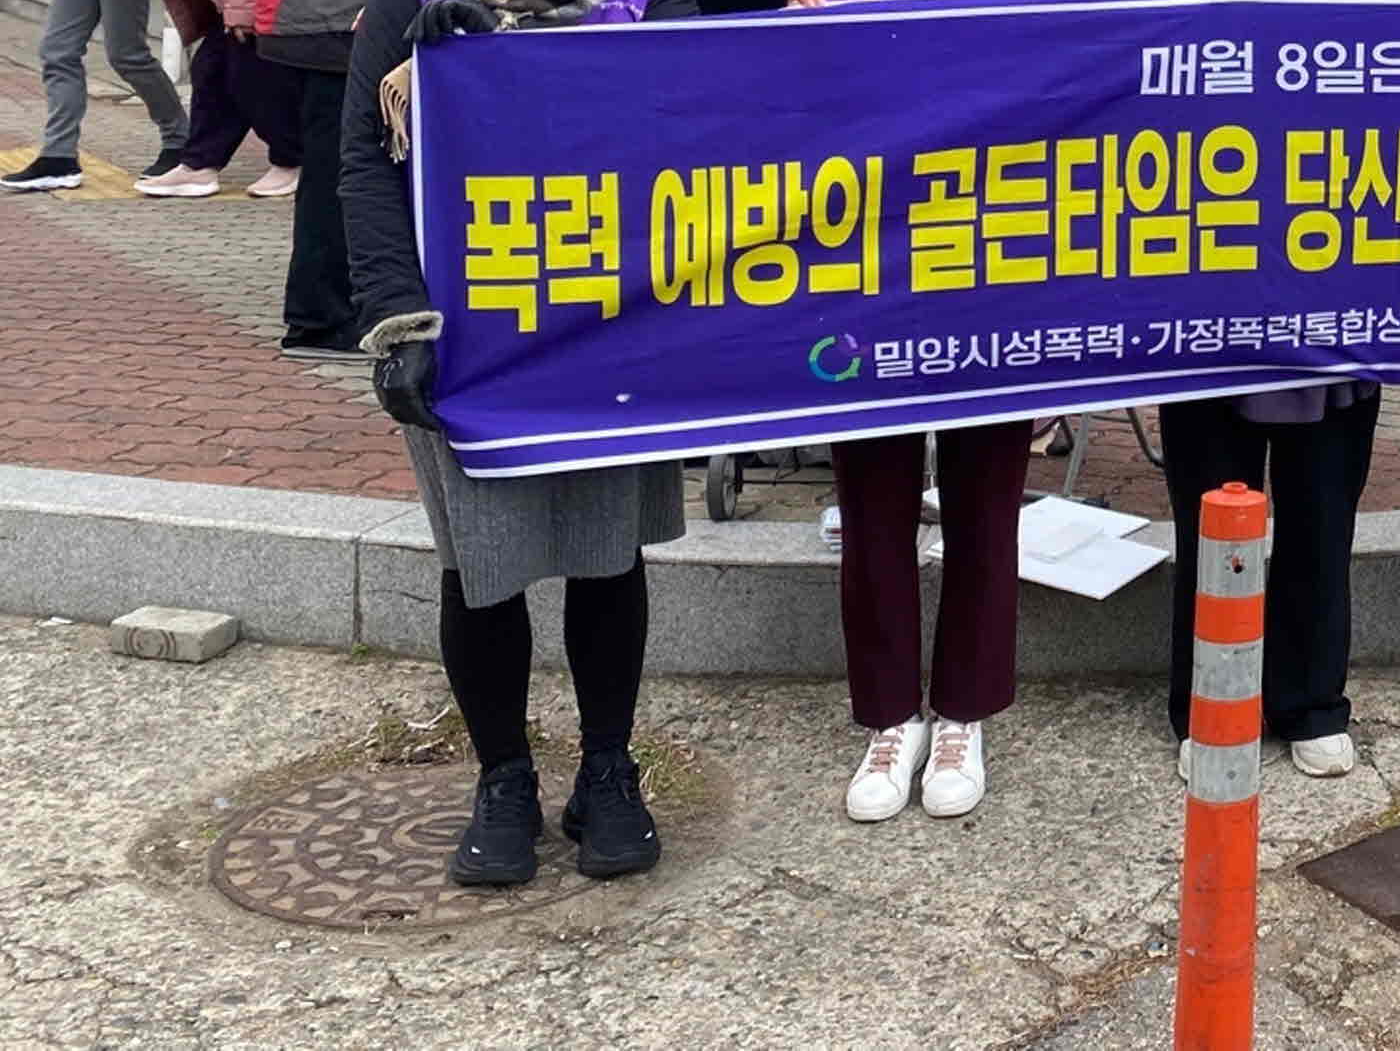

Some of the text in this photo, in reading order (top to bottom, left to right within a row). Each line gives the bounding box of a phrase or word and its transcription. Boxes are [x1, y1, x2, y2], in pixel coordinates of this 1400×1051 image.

[1139, 40, 1254, 96] 매월
[464, 171, 621, 333] 폭력
[650, 155, 884, 307] 예방의
[908, 125, 1260, 293] 골든타임은
